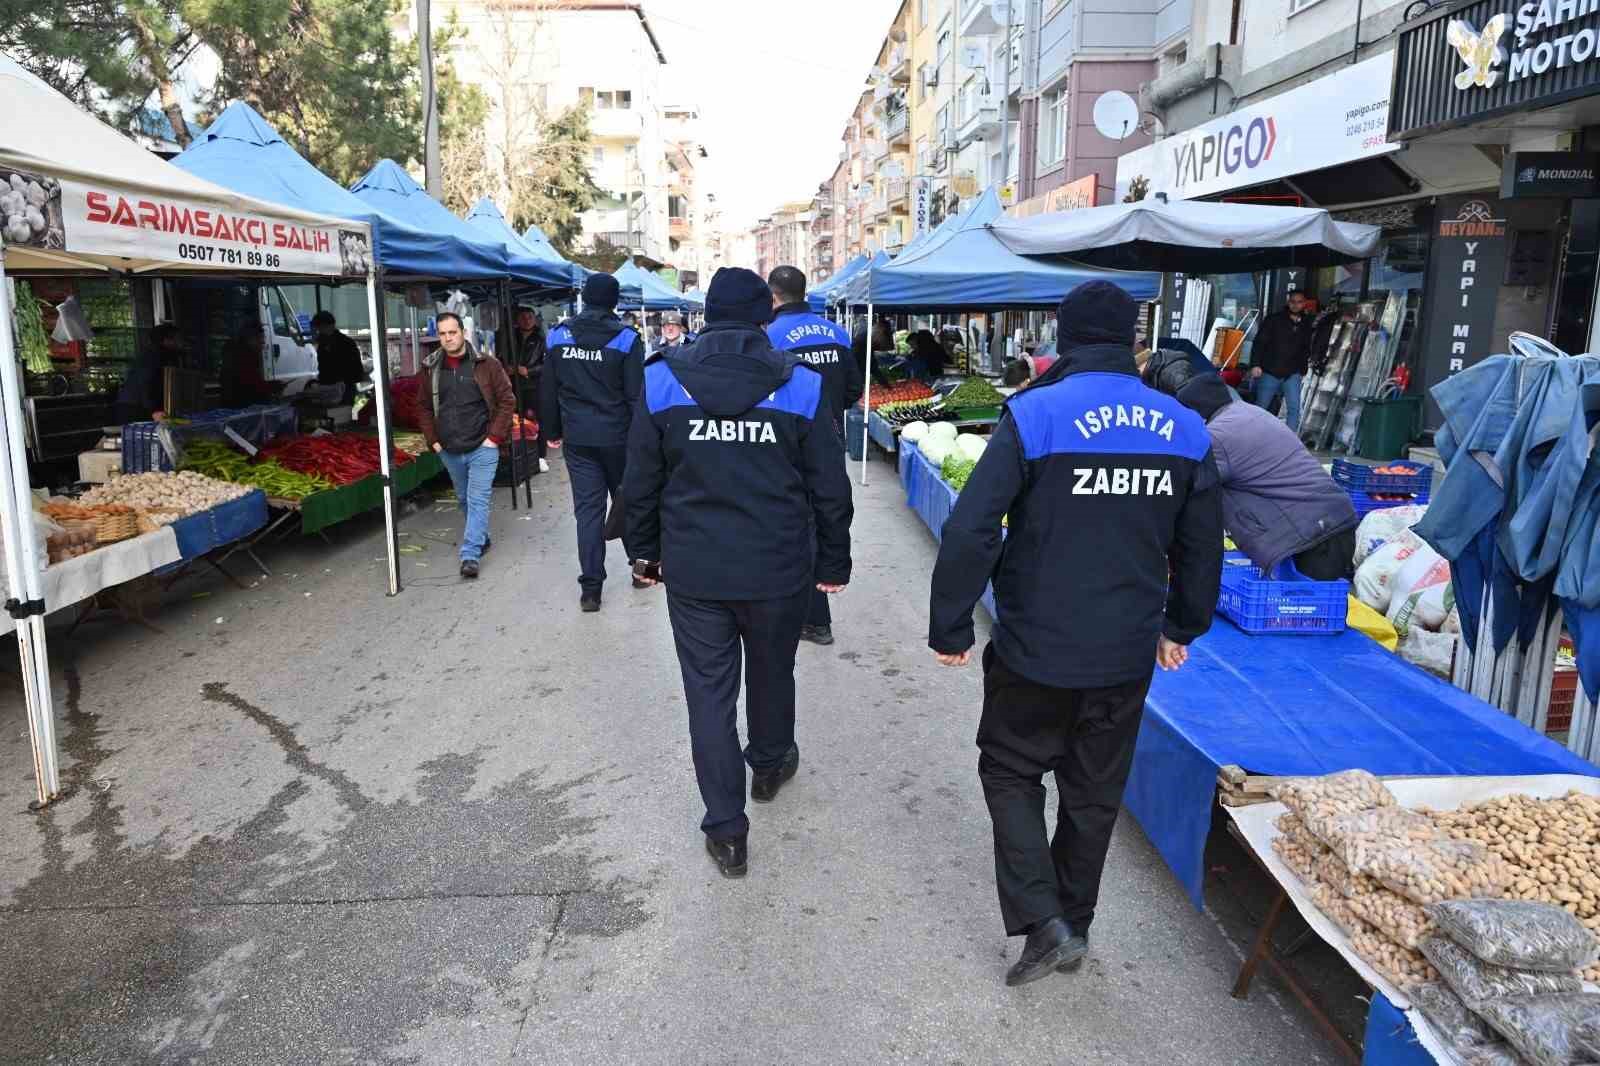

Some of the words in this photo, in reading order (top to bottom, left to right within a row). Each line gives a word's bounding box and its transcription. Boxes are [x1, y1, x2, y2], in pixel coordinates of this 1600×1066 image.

[1173, 117, 1267, 188] YAPIGO
[1537, 168, 1595, 180] MONDIAL
[86, 191, 267, 248] SARIMSAKÇI
[178, 243, 214, 261] 0507
[218, 247, 242, 264] 781
[247, 251, 262, 266] 89
[266, 253, 280, 268] 86
[1460, 241, 1479, 307] YAPI
[785, 324, 836, 344] ISPARTA
[562, 346, 603, 361] ZABITA
[796, 350, 839, 364] ABITA
[688, 419, 777, 443] ZABITA
[1074, 404, 1175, 442] ISPARTA
[1071, 467, 1174, 496] ZABITA
